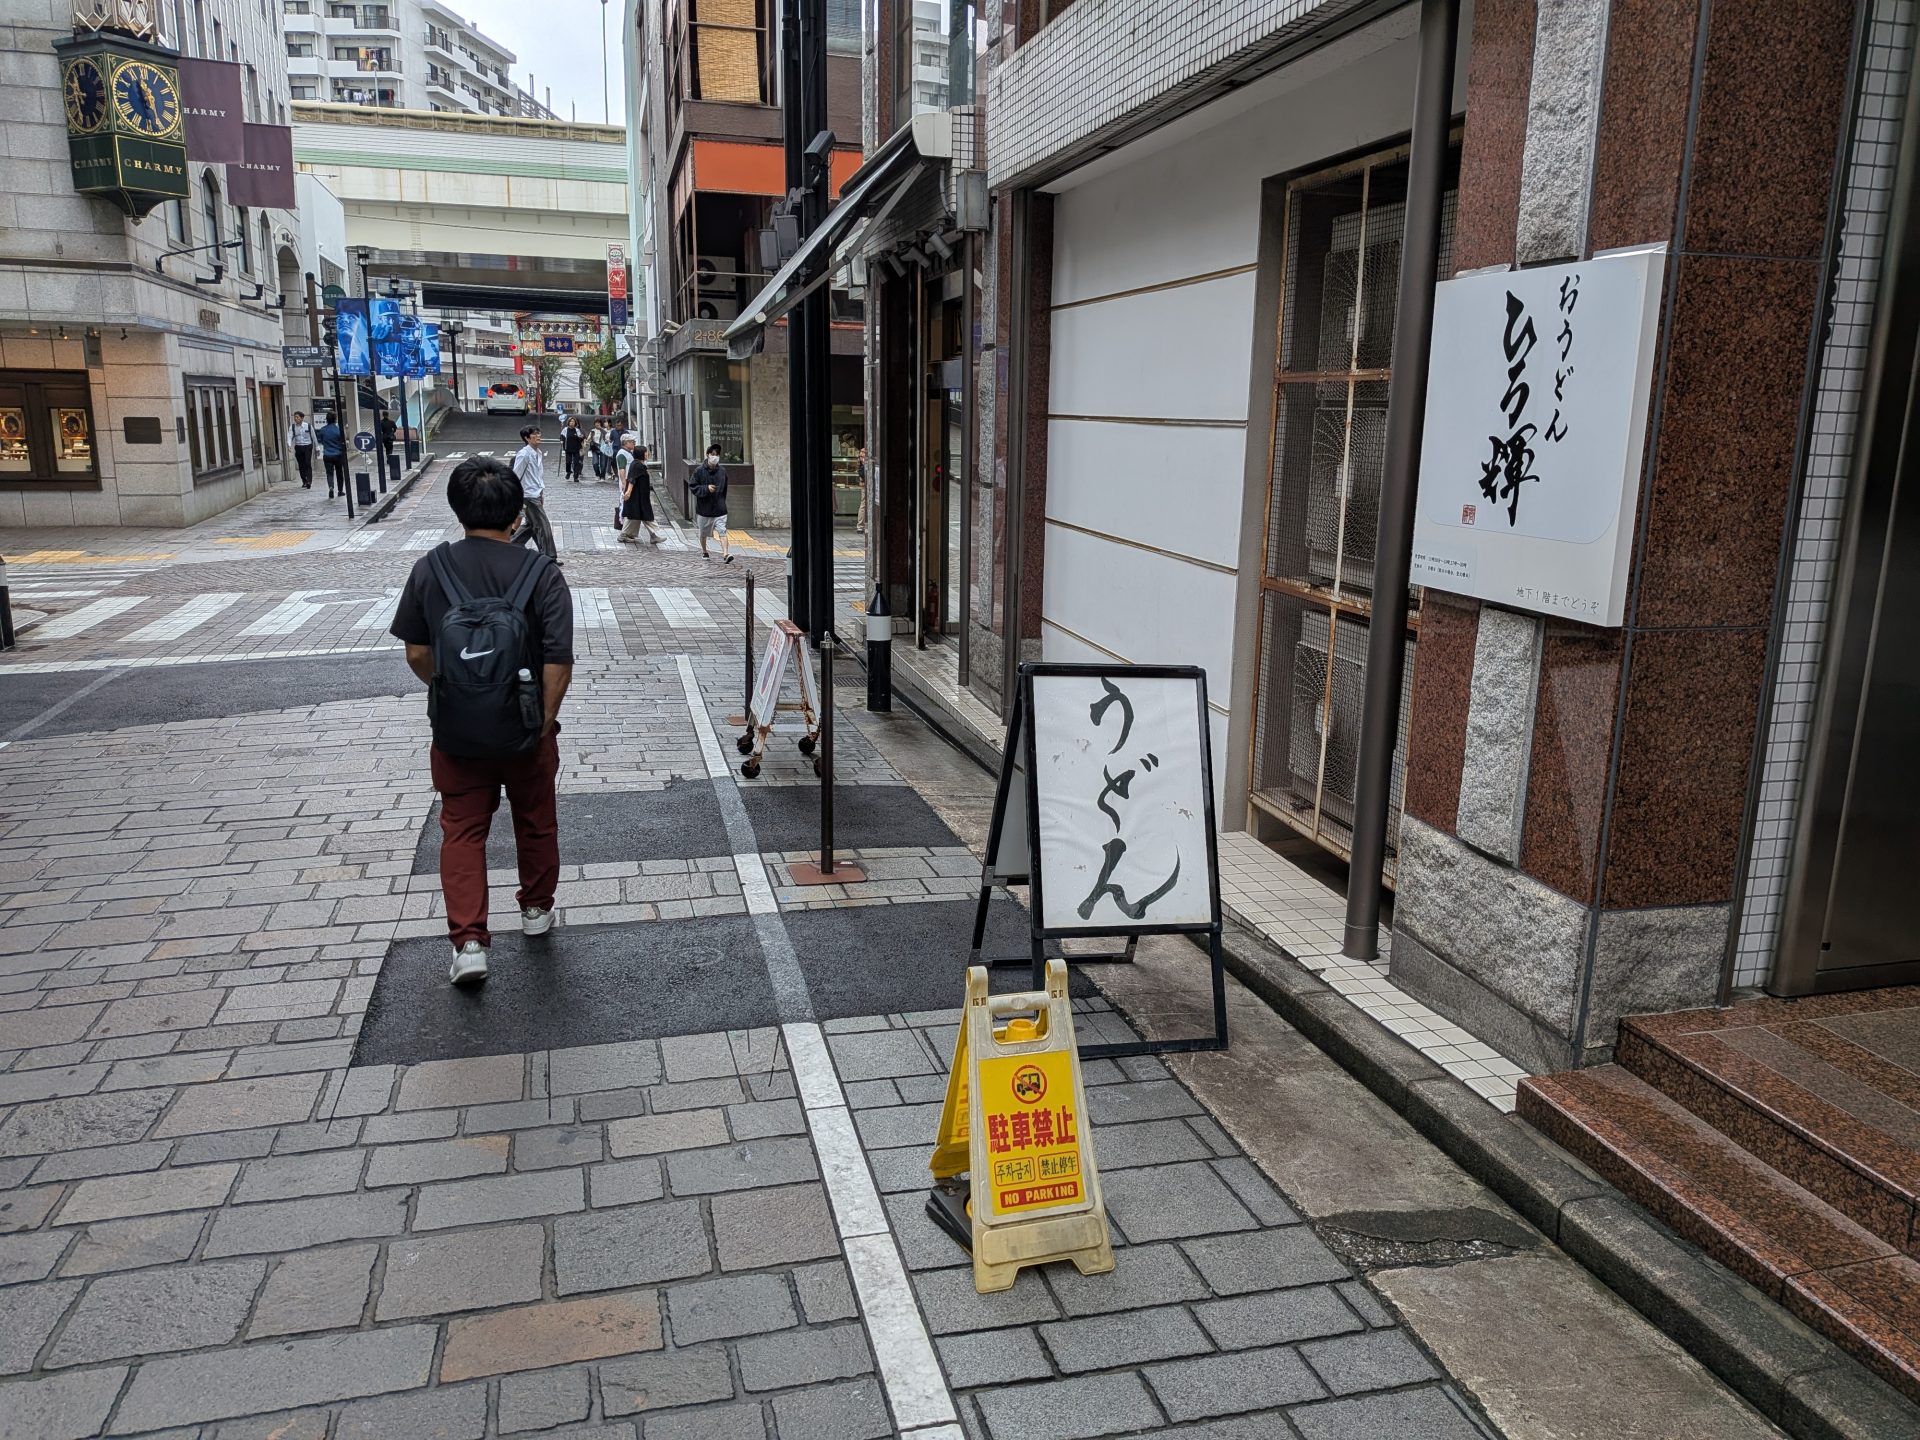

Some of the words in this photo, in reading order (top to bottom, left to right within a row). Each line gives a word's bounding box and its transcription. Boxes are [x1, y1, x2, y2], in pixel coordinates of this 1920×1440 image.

[184, 107, 227, 117] HARMY
[73, 157, 112, 169] CHARMY
[124, 158, 182, 175] CHARMY
[239, 163, 281, 172] CHARMY
[1544, 274, 1581, 443] おうどん
[1478, 289, 1540, 527] ひろ輝
[361, 438, 370, 450] P
[988, 1105, 1076, 1154] 駐車禁止
[996, 1160, 1032, 1182] 주차금지
[1004, 1192, 1019, 1205] NO
[1025, 1184, 1075, 1202] PARKING
